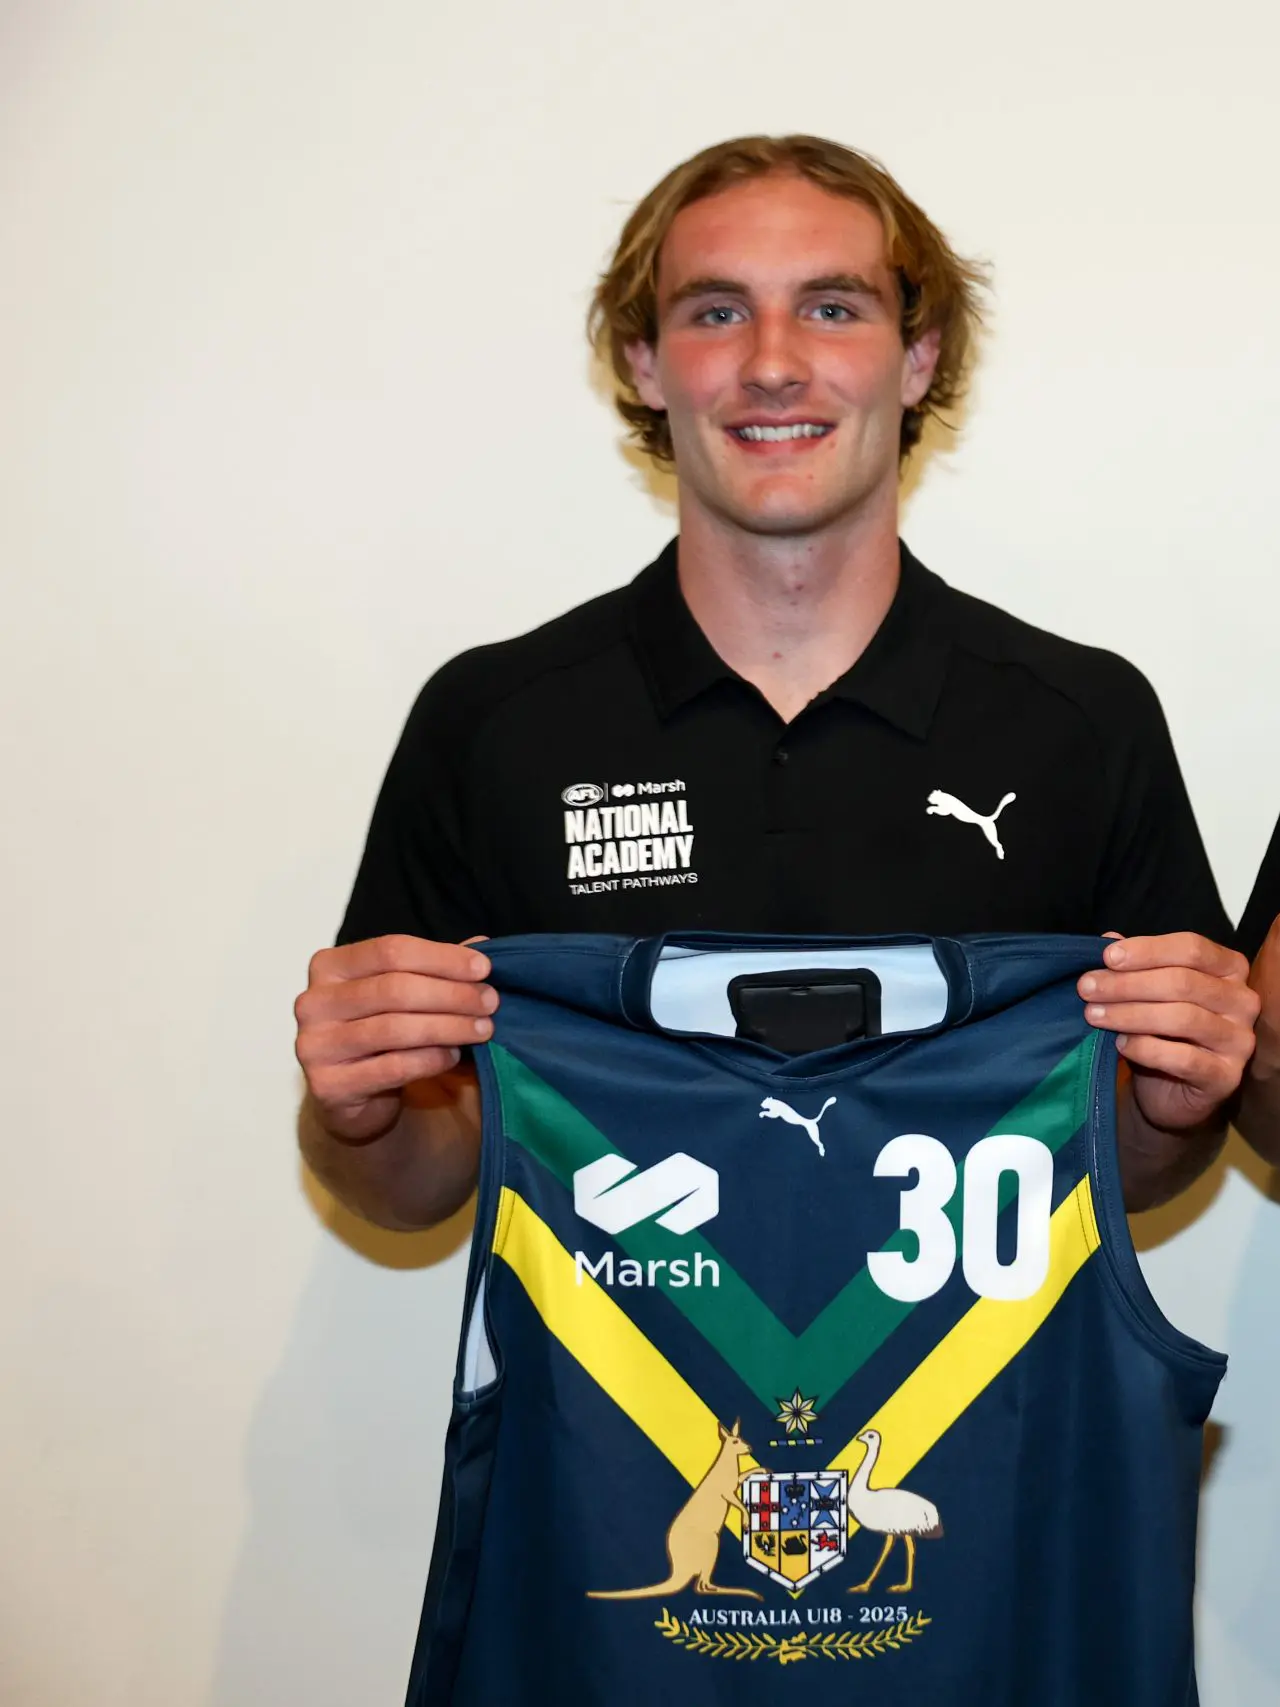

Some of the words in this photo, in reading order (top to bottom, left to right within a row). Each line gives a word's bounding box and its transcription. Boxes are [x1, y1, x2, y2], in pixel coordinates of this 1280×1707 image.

[567, 789, 600, 801] AFL
[637, 779, 686, 795] Marsh
[564, 800, 694, 844] NATIONAL
[567, 835, 695, 880] ACADEMY
[568, 879, 621, 896] TALENT
[622, 872, 699, 890] PATHWAYS
[867, 1133, 1054, 1303] 30
[573, 1252, 721, 1288] Marsh
[689, 1608, 801, 1626] AUSTRALIA
[806, 1607, 842, 1625] U18
[859, 1606, 909, 1624] 2025
